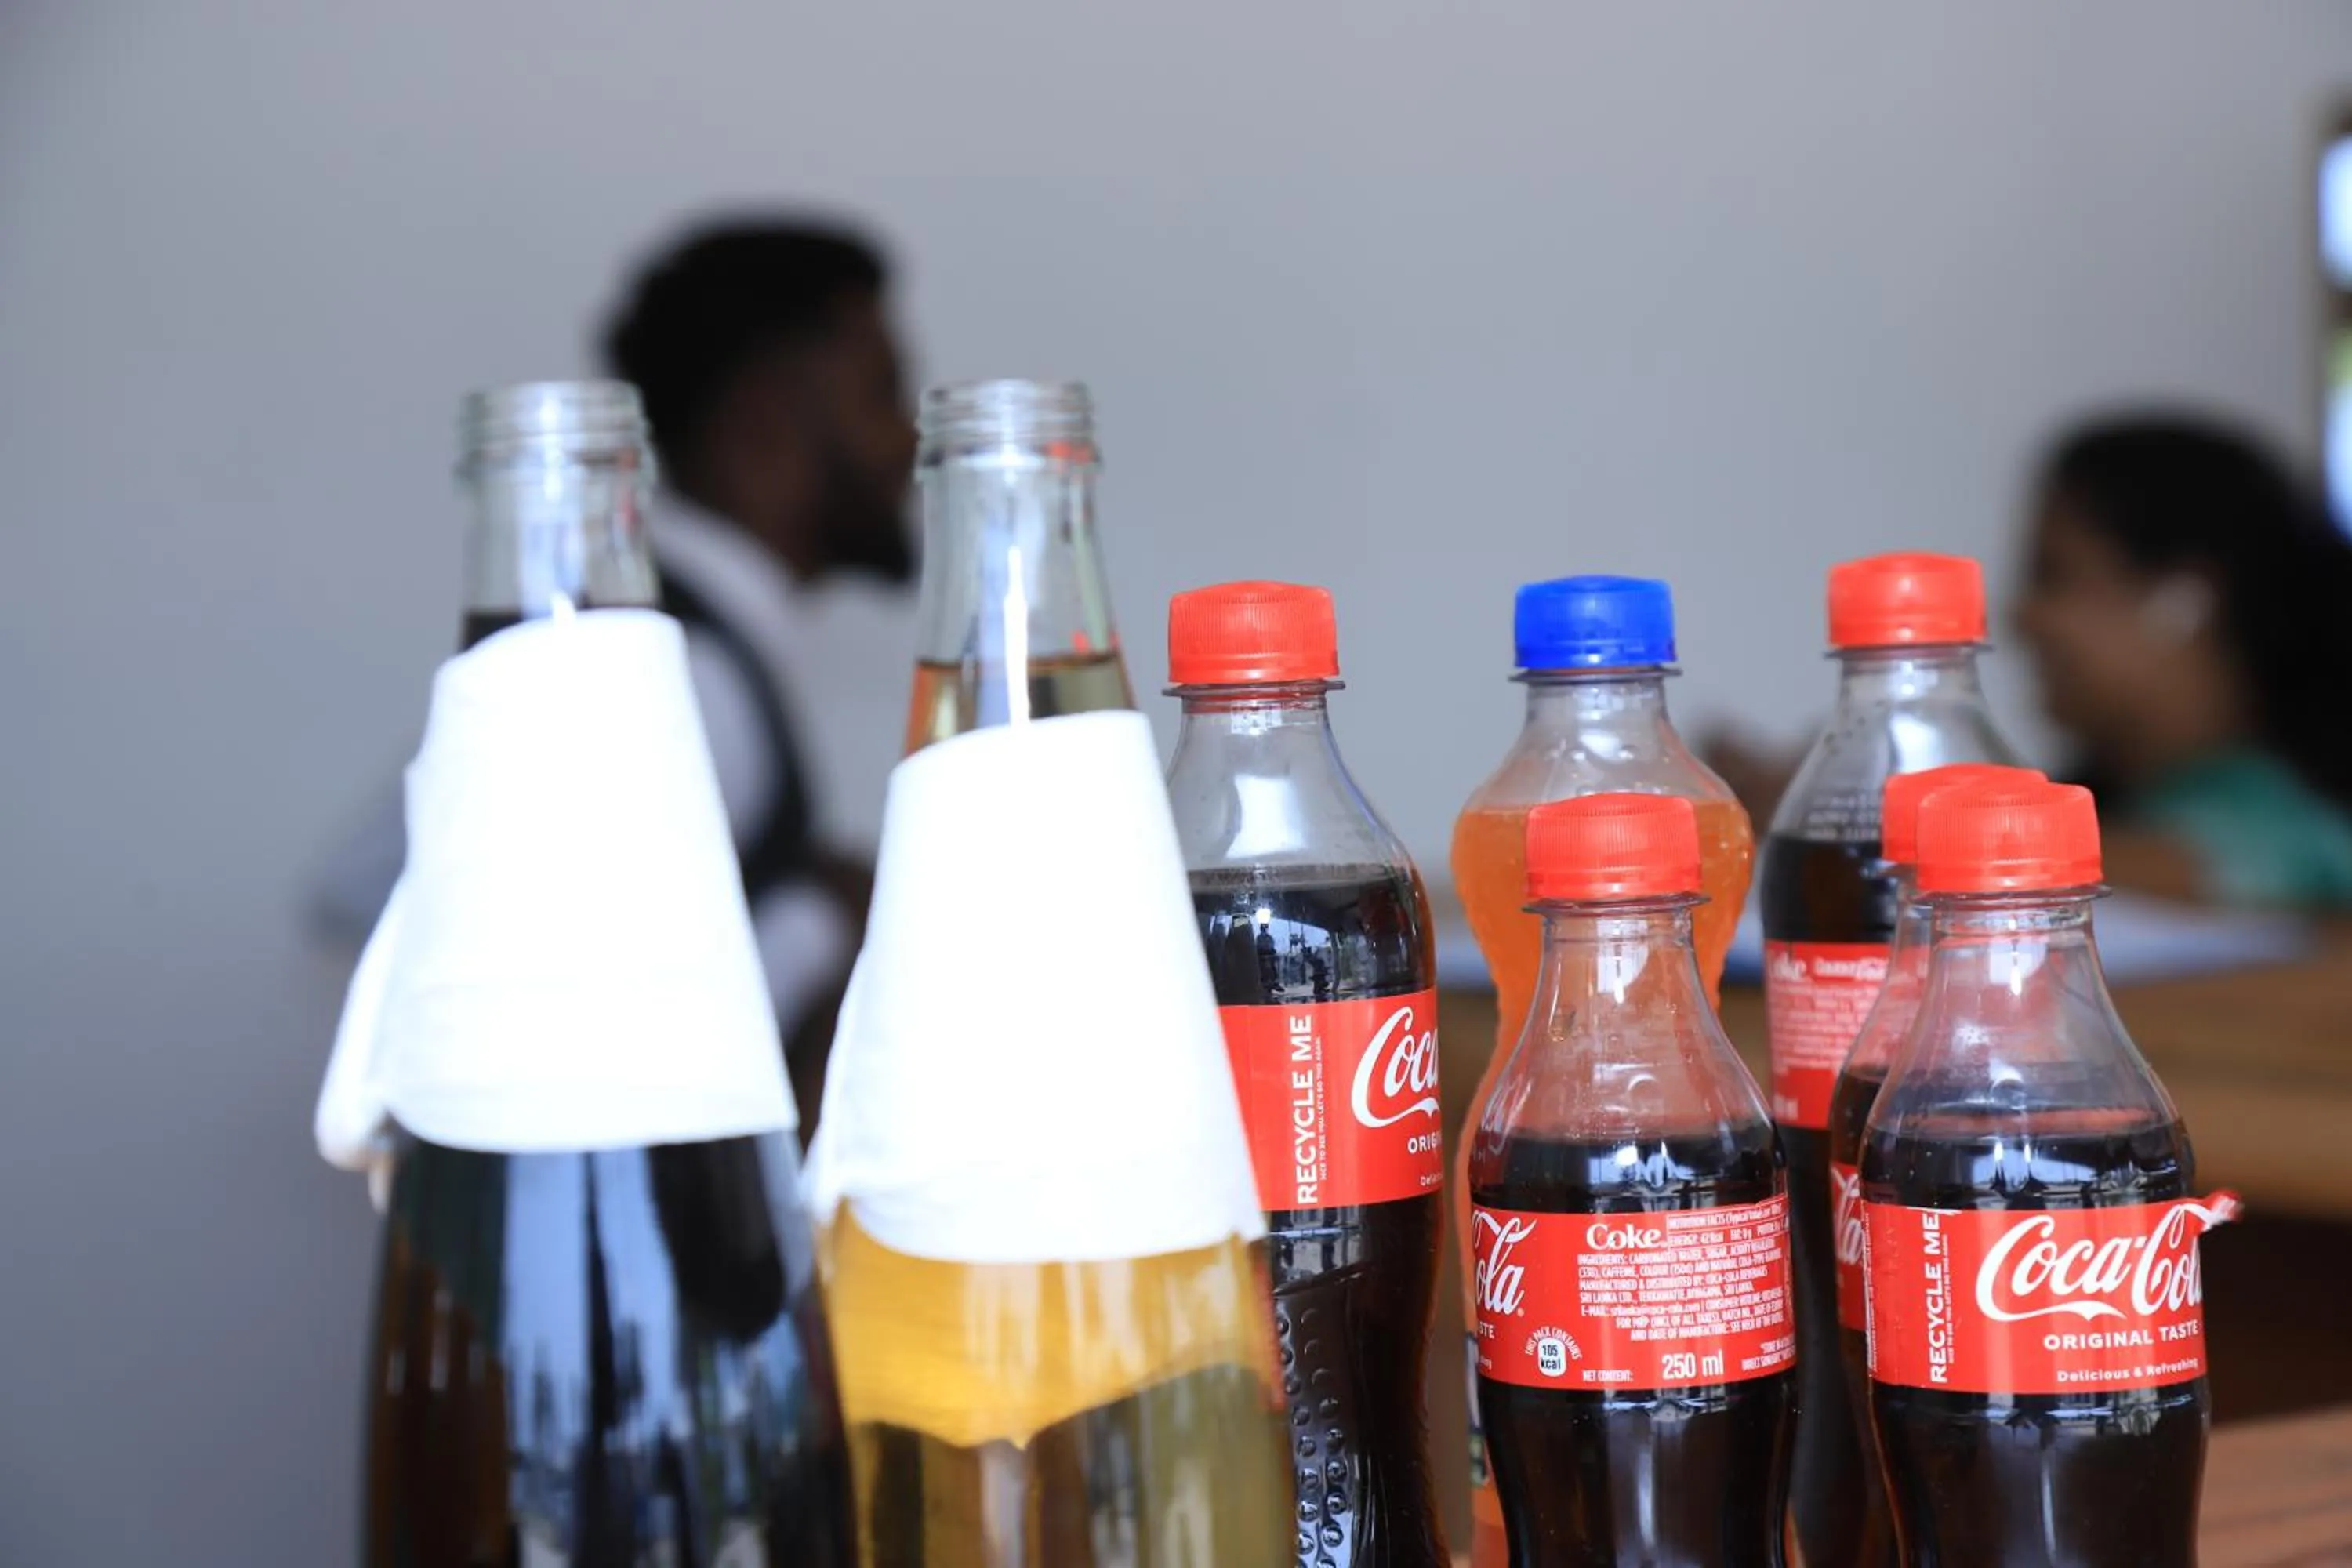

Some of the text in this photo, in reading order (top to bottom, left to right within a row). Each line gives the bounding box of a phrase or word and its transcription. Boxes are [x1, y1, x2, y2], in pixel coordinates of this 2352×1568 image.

[1290, 1014, 1319, 1205] RECYCLE ME
[1586, 1222, 1661, 1250] Coke
[1922, 1212, 1941, 1255] ME
[1479, 1321, 1495, 1339] STE
[1925, 1262, 1948, 1383] RECYCLE
[2044, 1319, 2199, 1351] ORIGINAL TASTE
[1541, 1358, 1561, 1370] kcal
[1542, 1344, 1559, 1356] 105
[1661, 1352, 1697, 1380] 250
[1702, 1348, 1725, 1377] ml
[2057, 1367, 2130, 1382] Delicious
[2133, 1366, 2144, 1378] &
